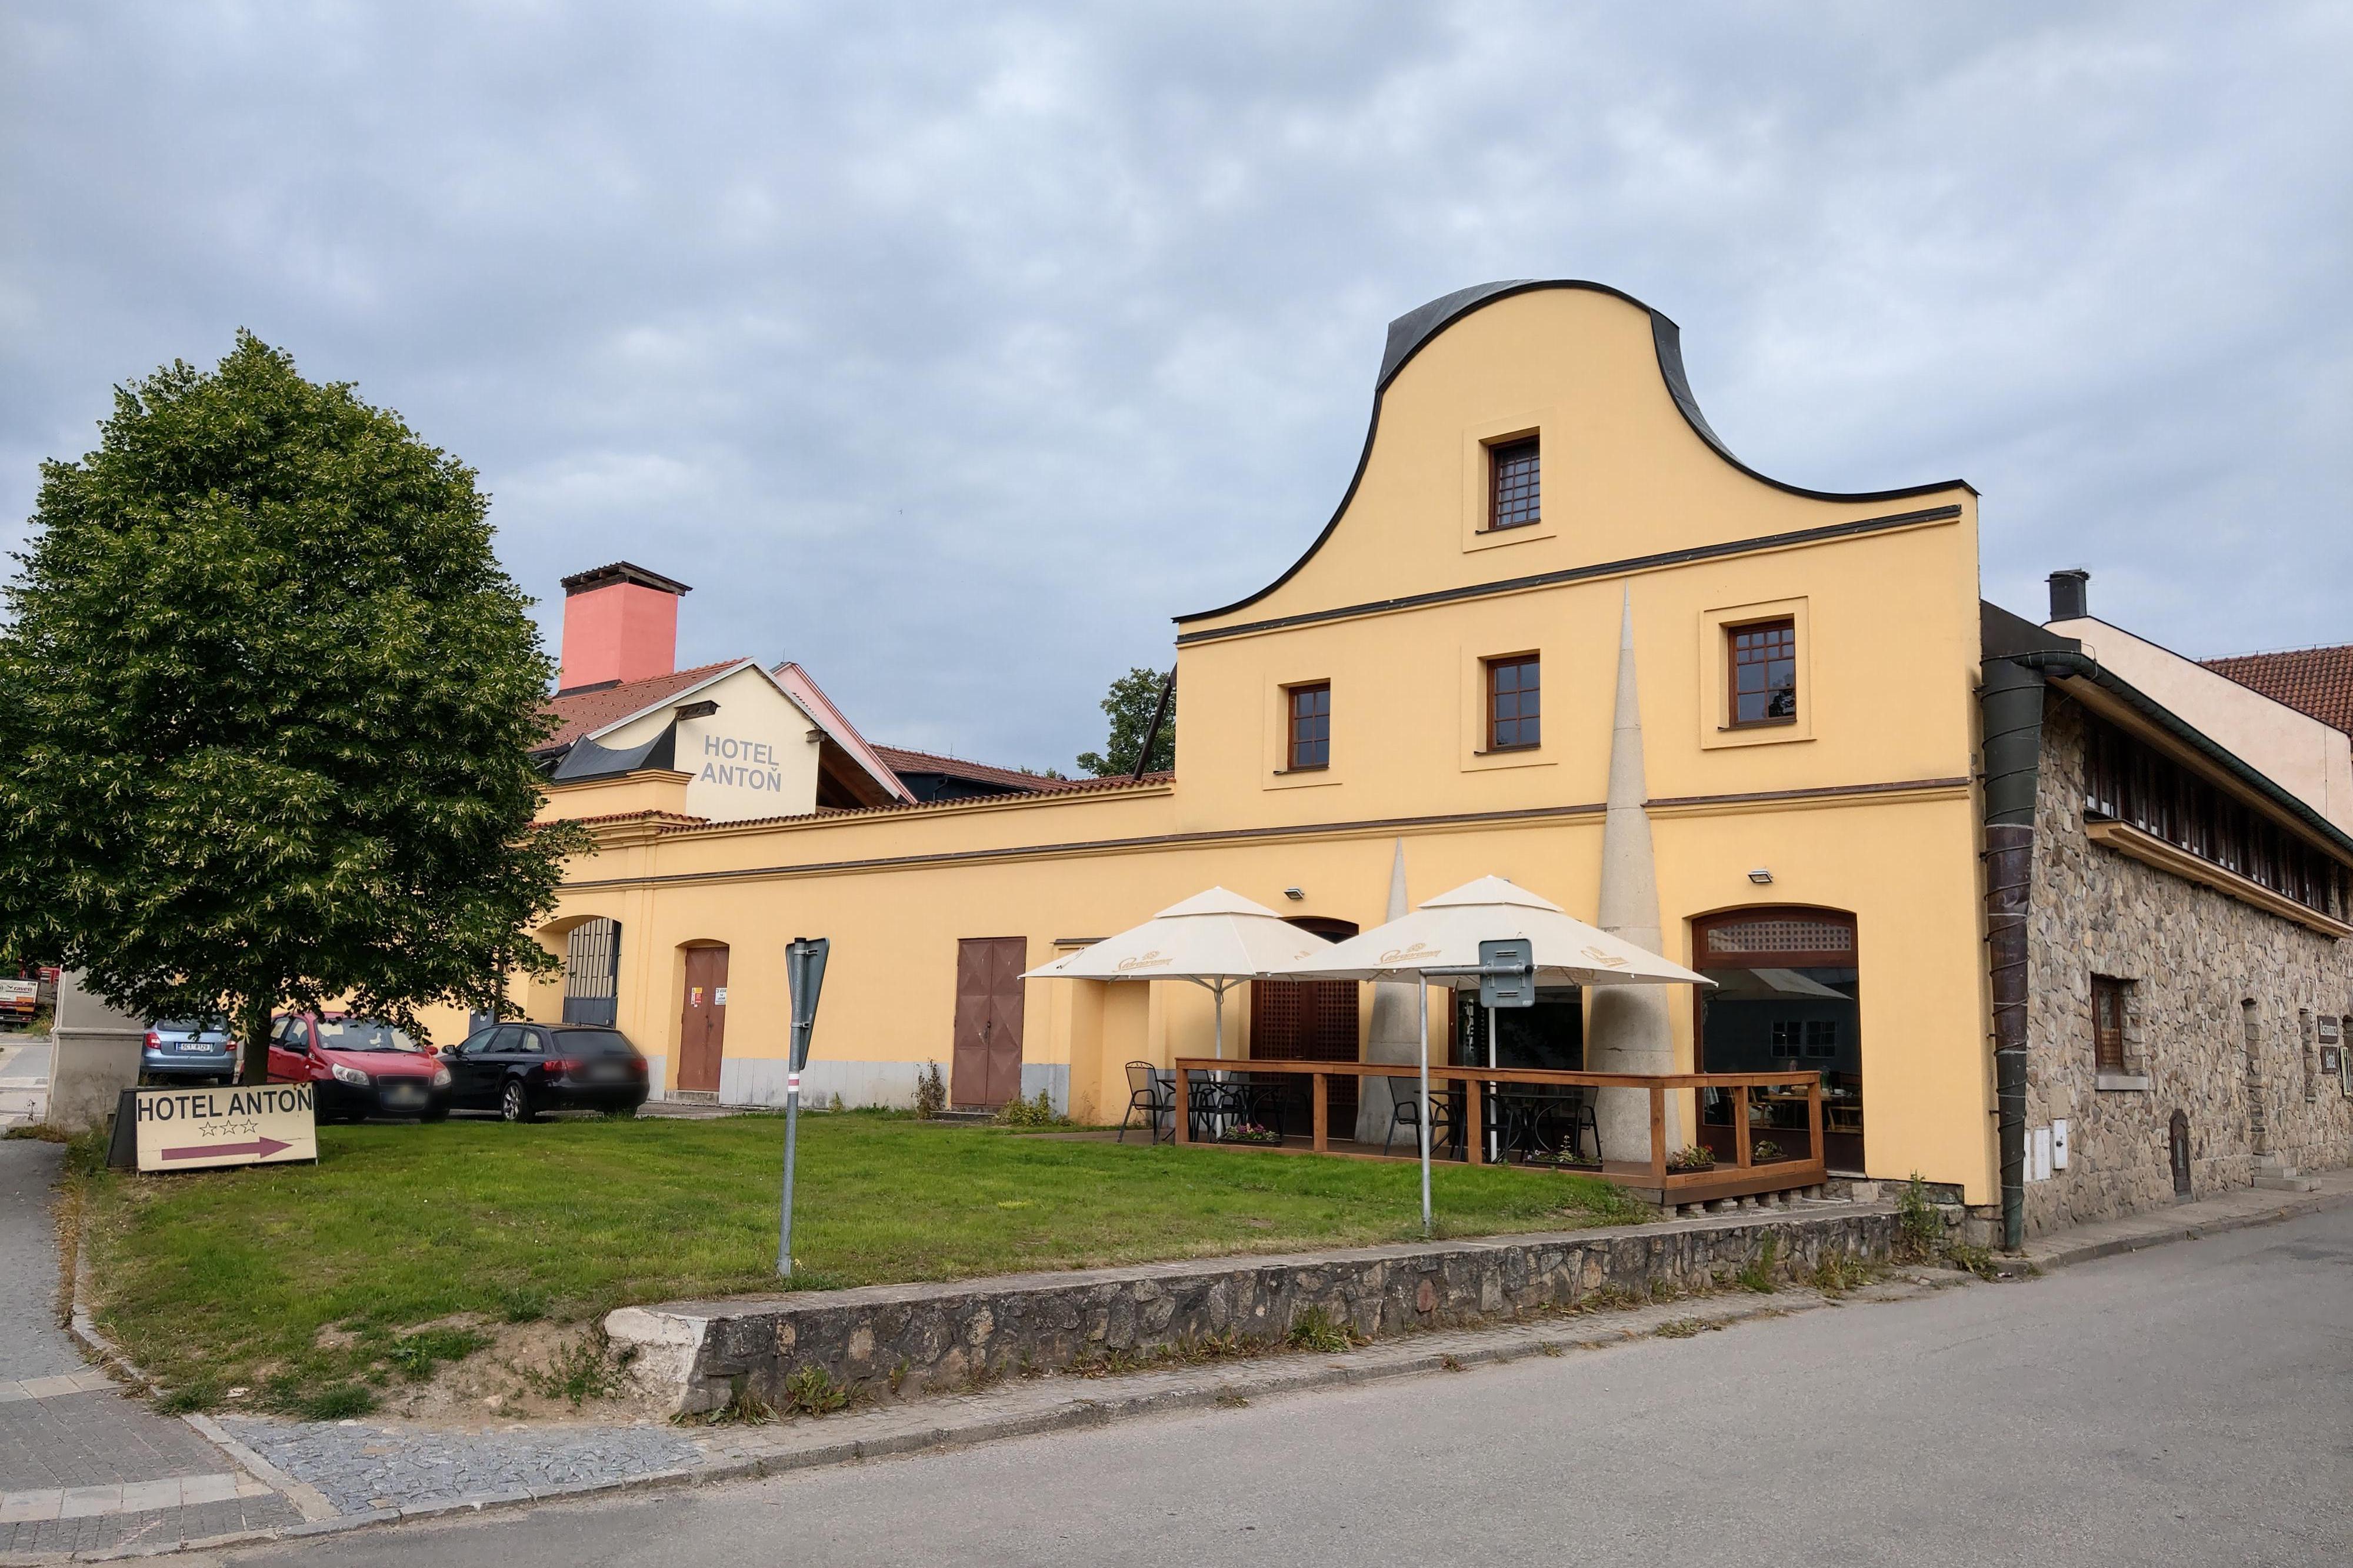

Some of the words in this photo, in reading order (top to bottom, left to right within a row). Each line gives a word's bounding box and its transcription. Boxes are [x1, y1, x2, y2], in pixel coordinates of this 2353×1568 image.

[705, 735, 779, 766] HOTEL
[699, 762, 781, 792] ANTOŇ
[138, 1095, 222, 1122] HOTEL
[228, 1083, 313, 1116] ANTOŇ
